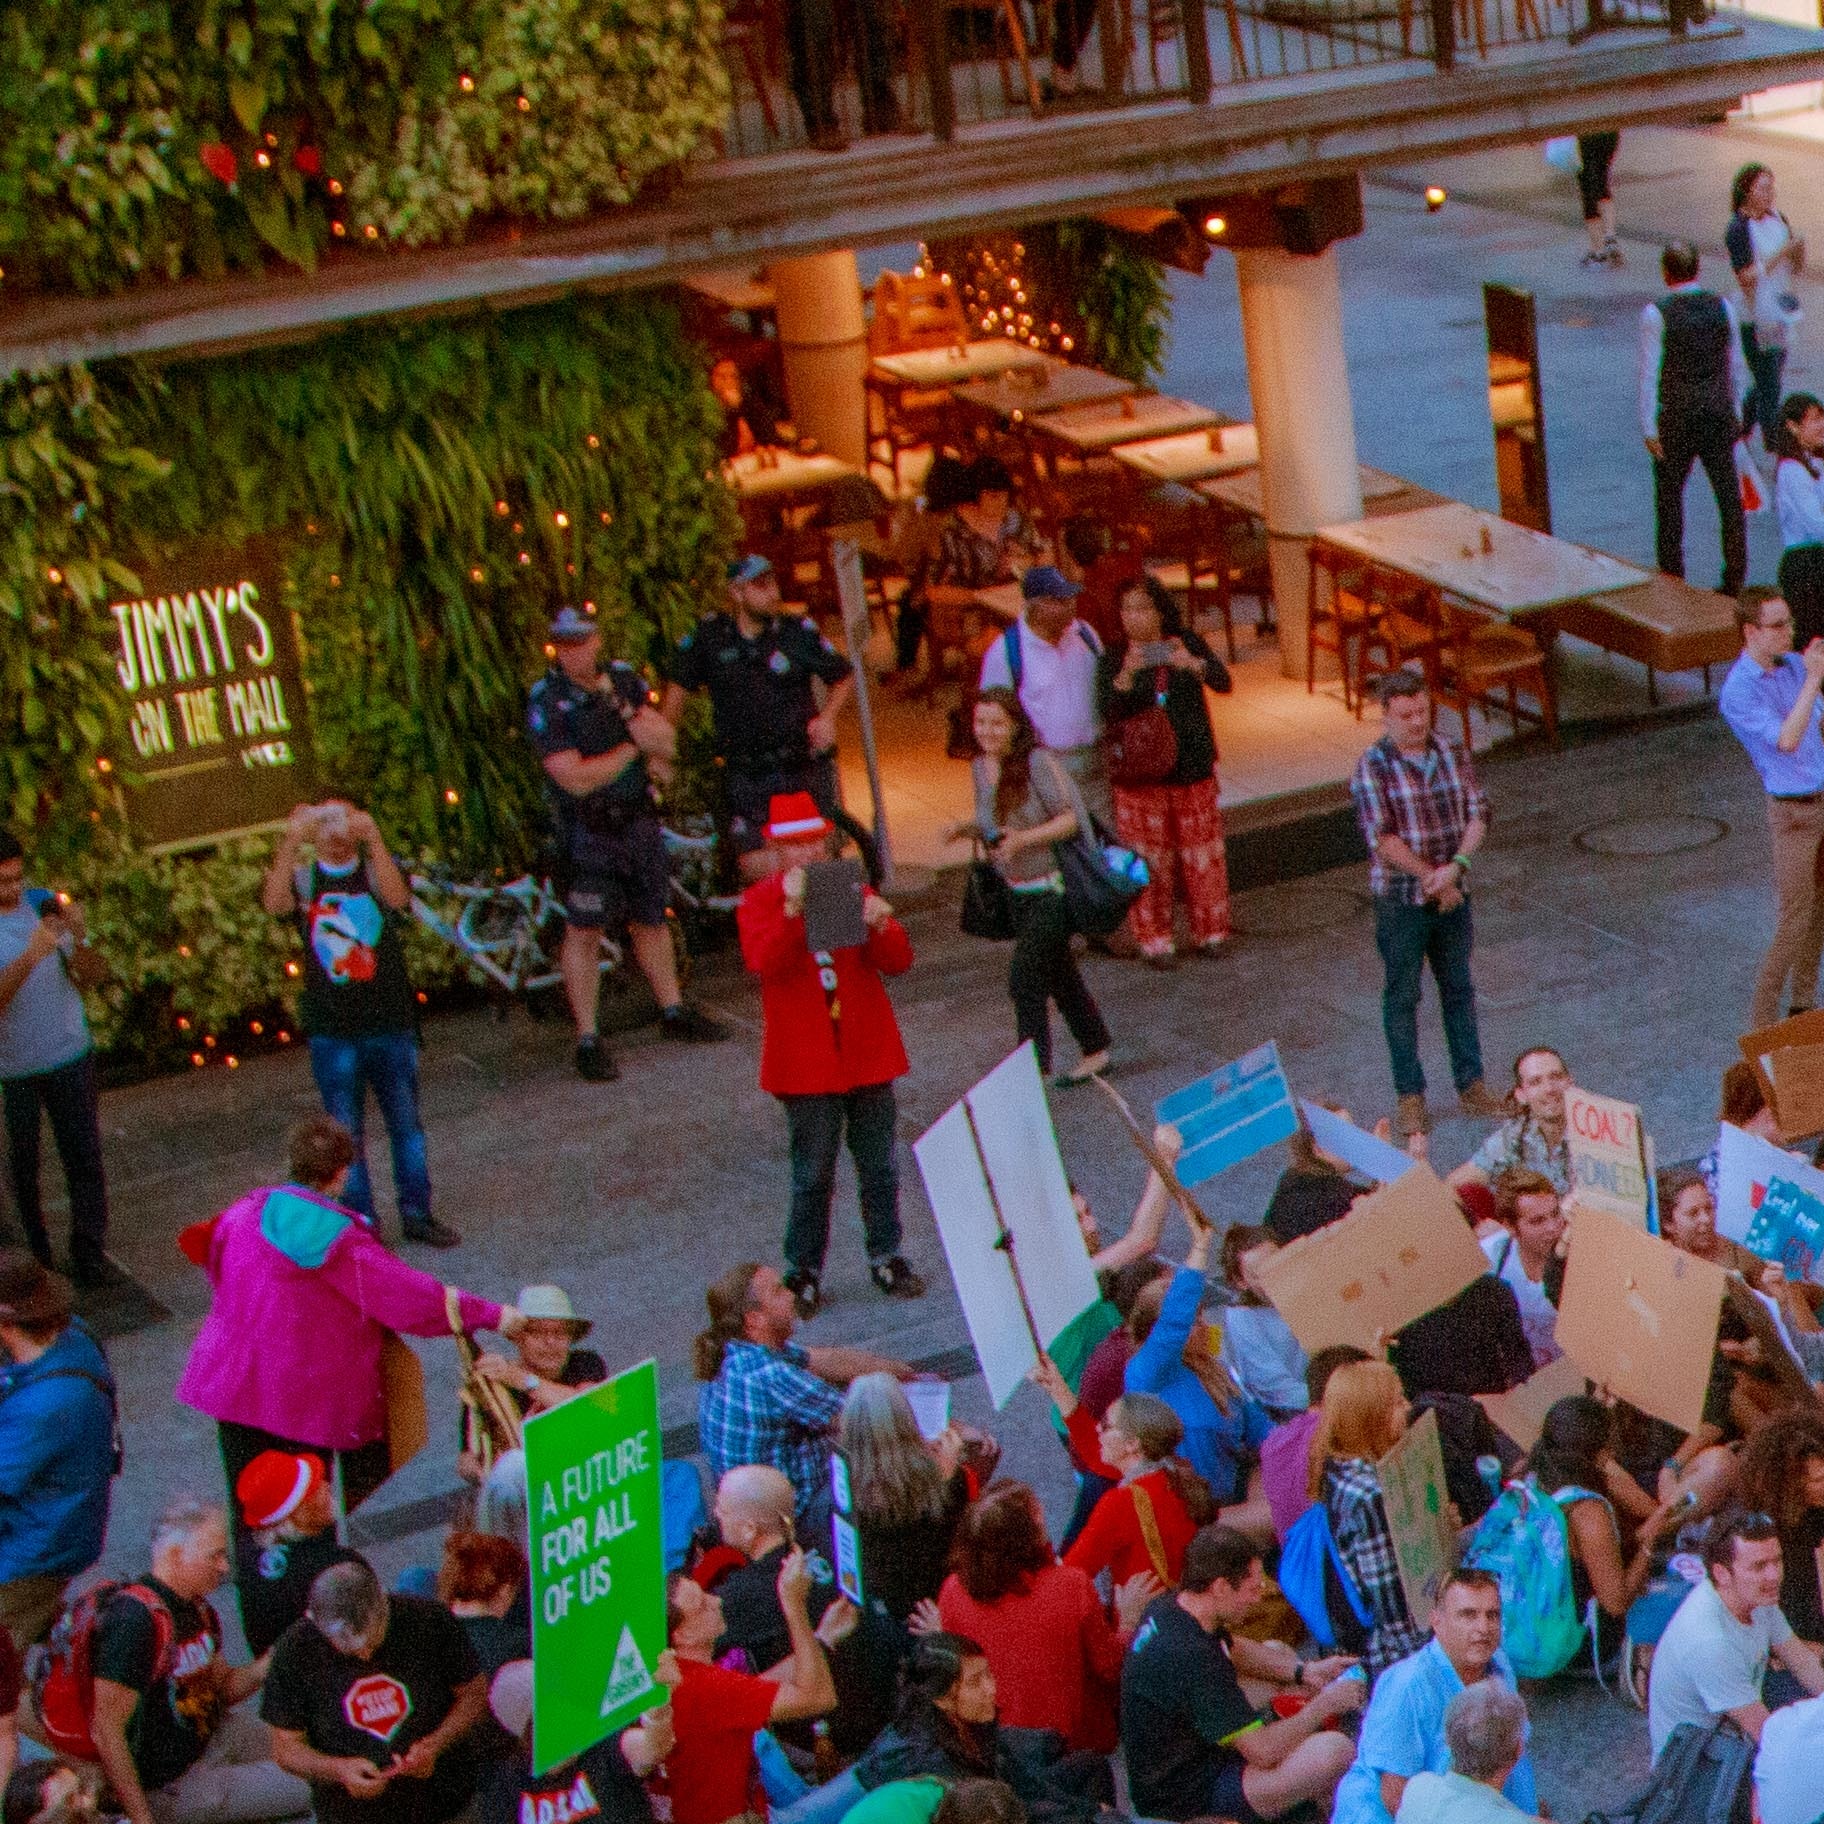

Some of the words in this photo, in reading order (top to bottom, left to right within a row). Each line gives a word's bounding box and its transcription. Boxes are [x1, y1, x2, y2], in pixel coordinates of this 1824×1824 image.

[110, 579, 275, 692] JIMMY'S
[130, 698, 175, 758] ON
[173, 686, 224, 748] THE
[225, 675, 292, 736] MALL
[542, 1480, 558, 1522] A
[562, 1430, 650, 1508] FUTURE
[541, 1515, 587, 1575] FOR
[594, 1491, 638, 1548] ALL
[543, 1576, 575, 1625] OF
[579, 1555, 612, 1606] US
